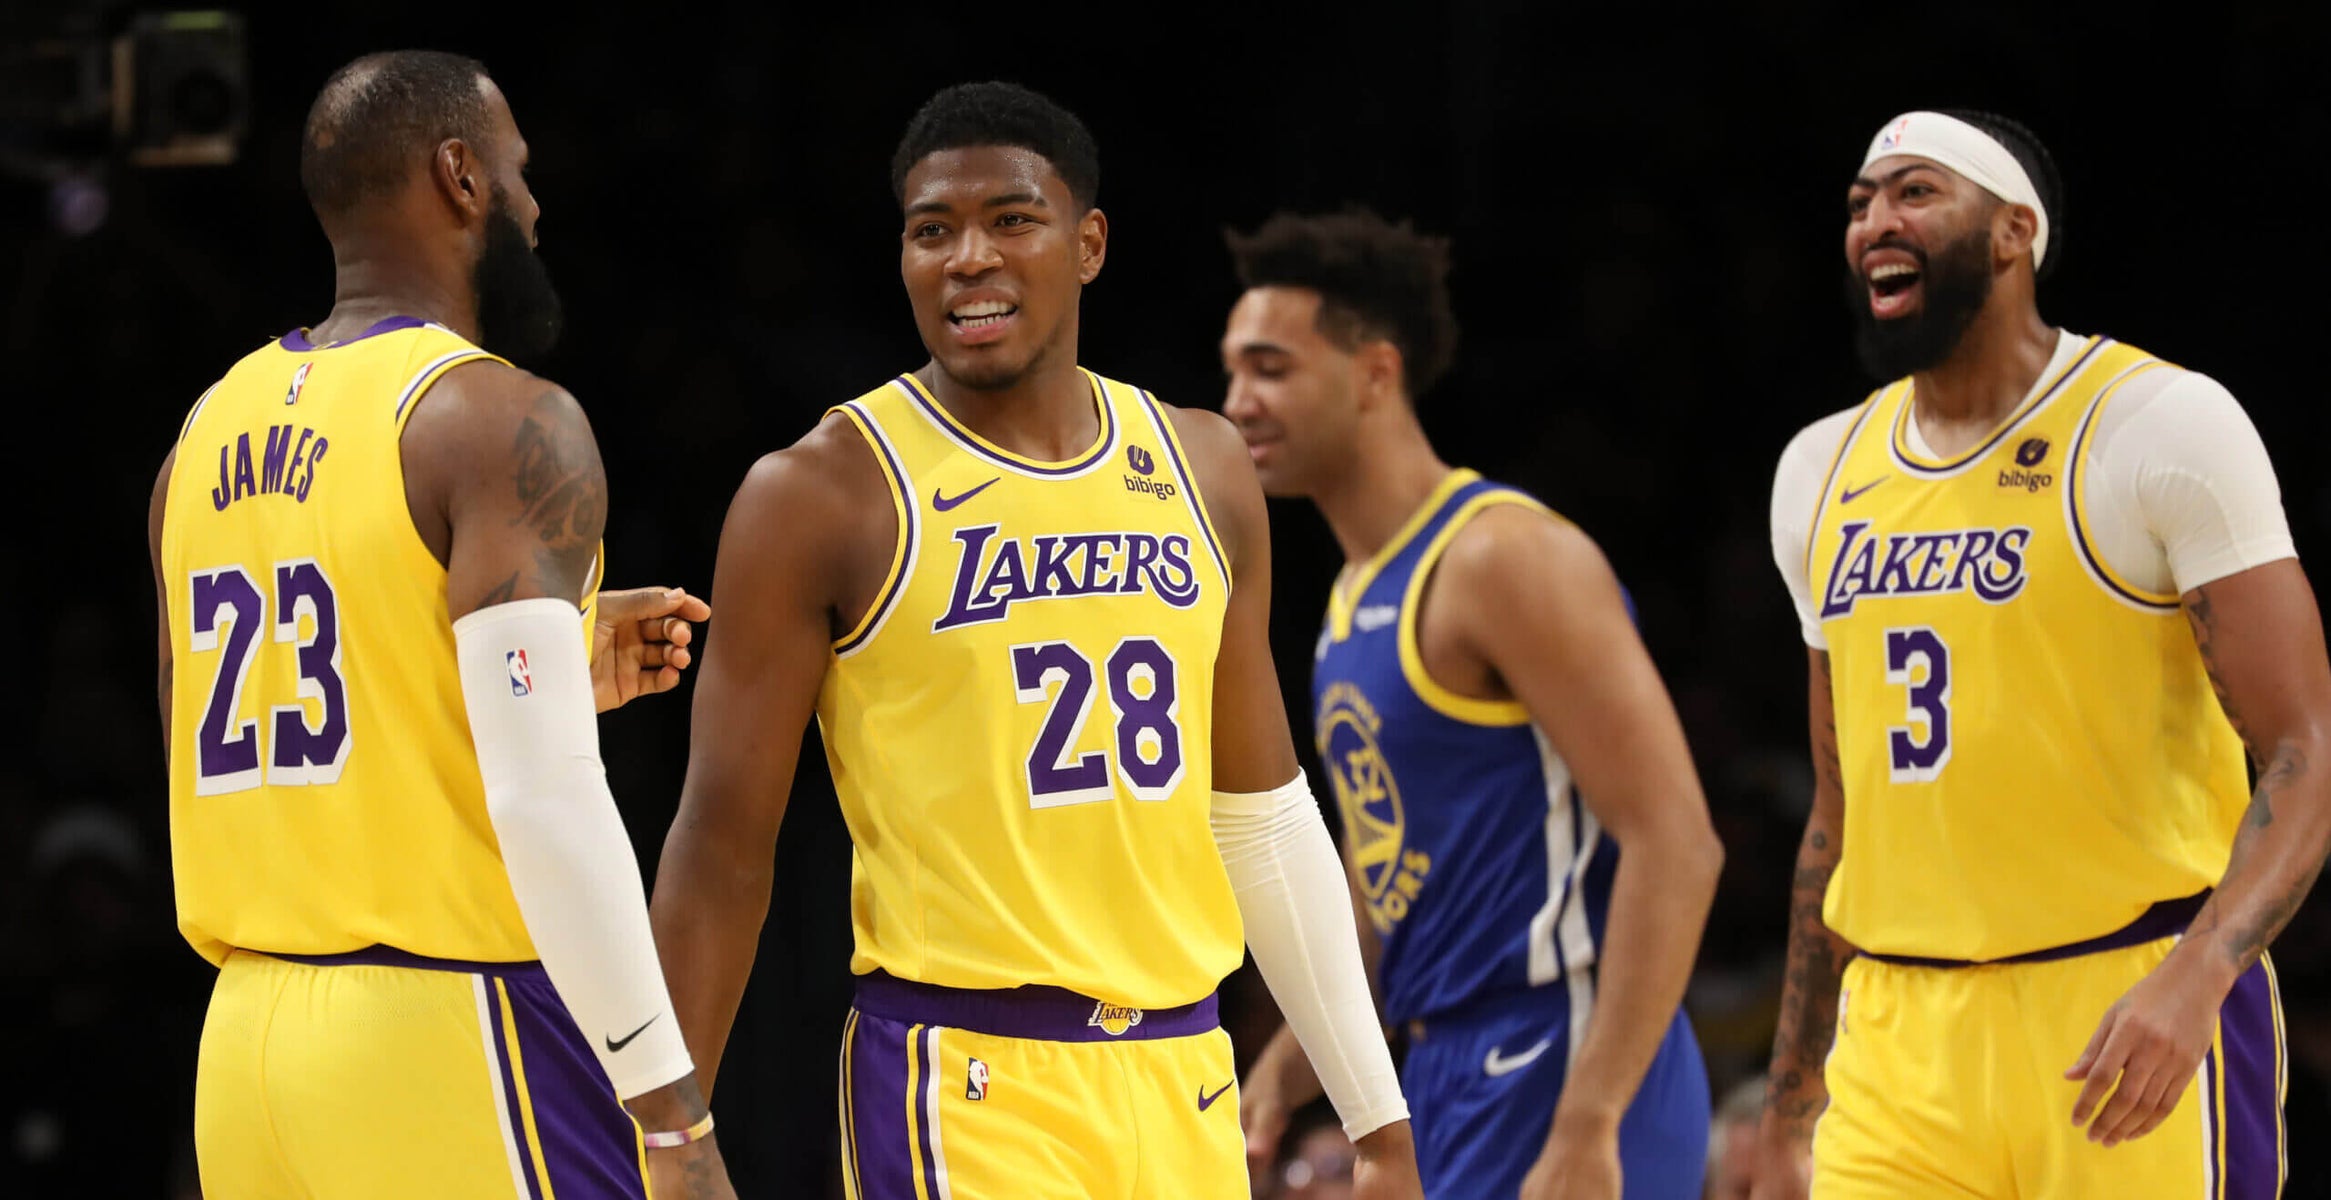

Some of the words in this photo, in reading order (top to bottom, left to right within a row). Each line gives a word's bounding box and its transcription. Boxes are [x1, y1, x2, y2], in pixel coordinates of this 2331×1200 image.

[212, 424, 328, 511] JAMES
[1125, 475, 1176, 500] bibigo
[1998, 470, 2052, 492] bibigo
[931, 521, 1200, 634] LAKERS
[1819, 518, 2034, 622] LAKERS
[189, 557, 353, 797] 23
[1008, 636, 1187, 810] 28
[1884, 625, 1952, 784] 3
